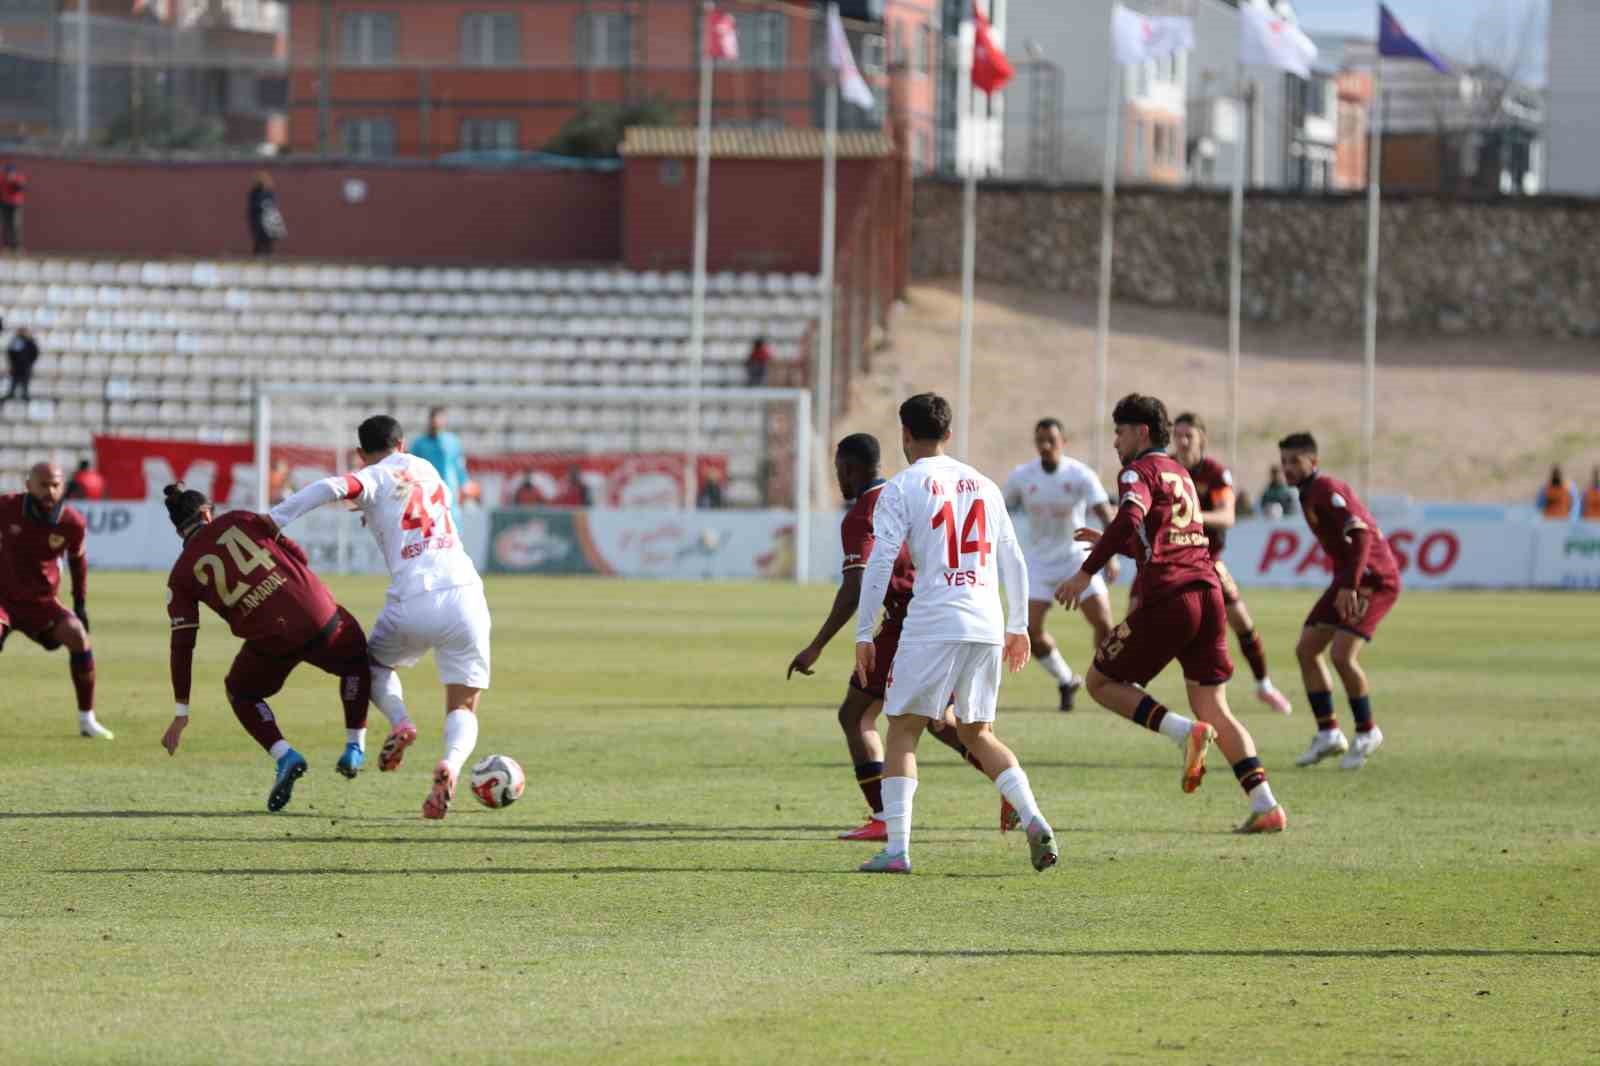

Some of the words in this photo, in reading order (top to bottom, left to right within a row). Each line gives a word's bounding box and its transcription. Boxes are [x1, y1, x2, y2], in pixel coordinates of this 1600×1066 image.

[401, 484, 452, 538] 41
[931, 498, 991, 569] 14
[193, 525, 276, 607] 24
[1257, 527, 1461, 577] PASO
